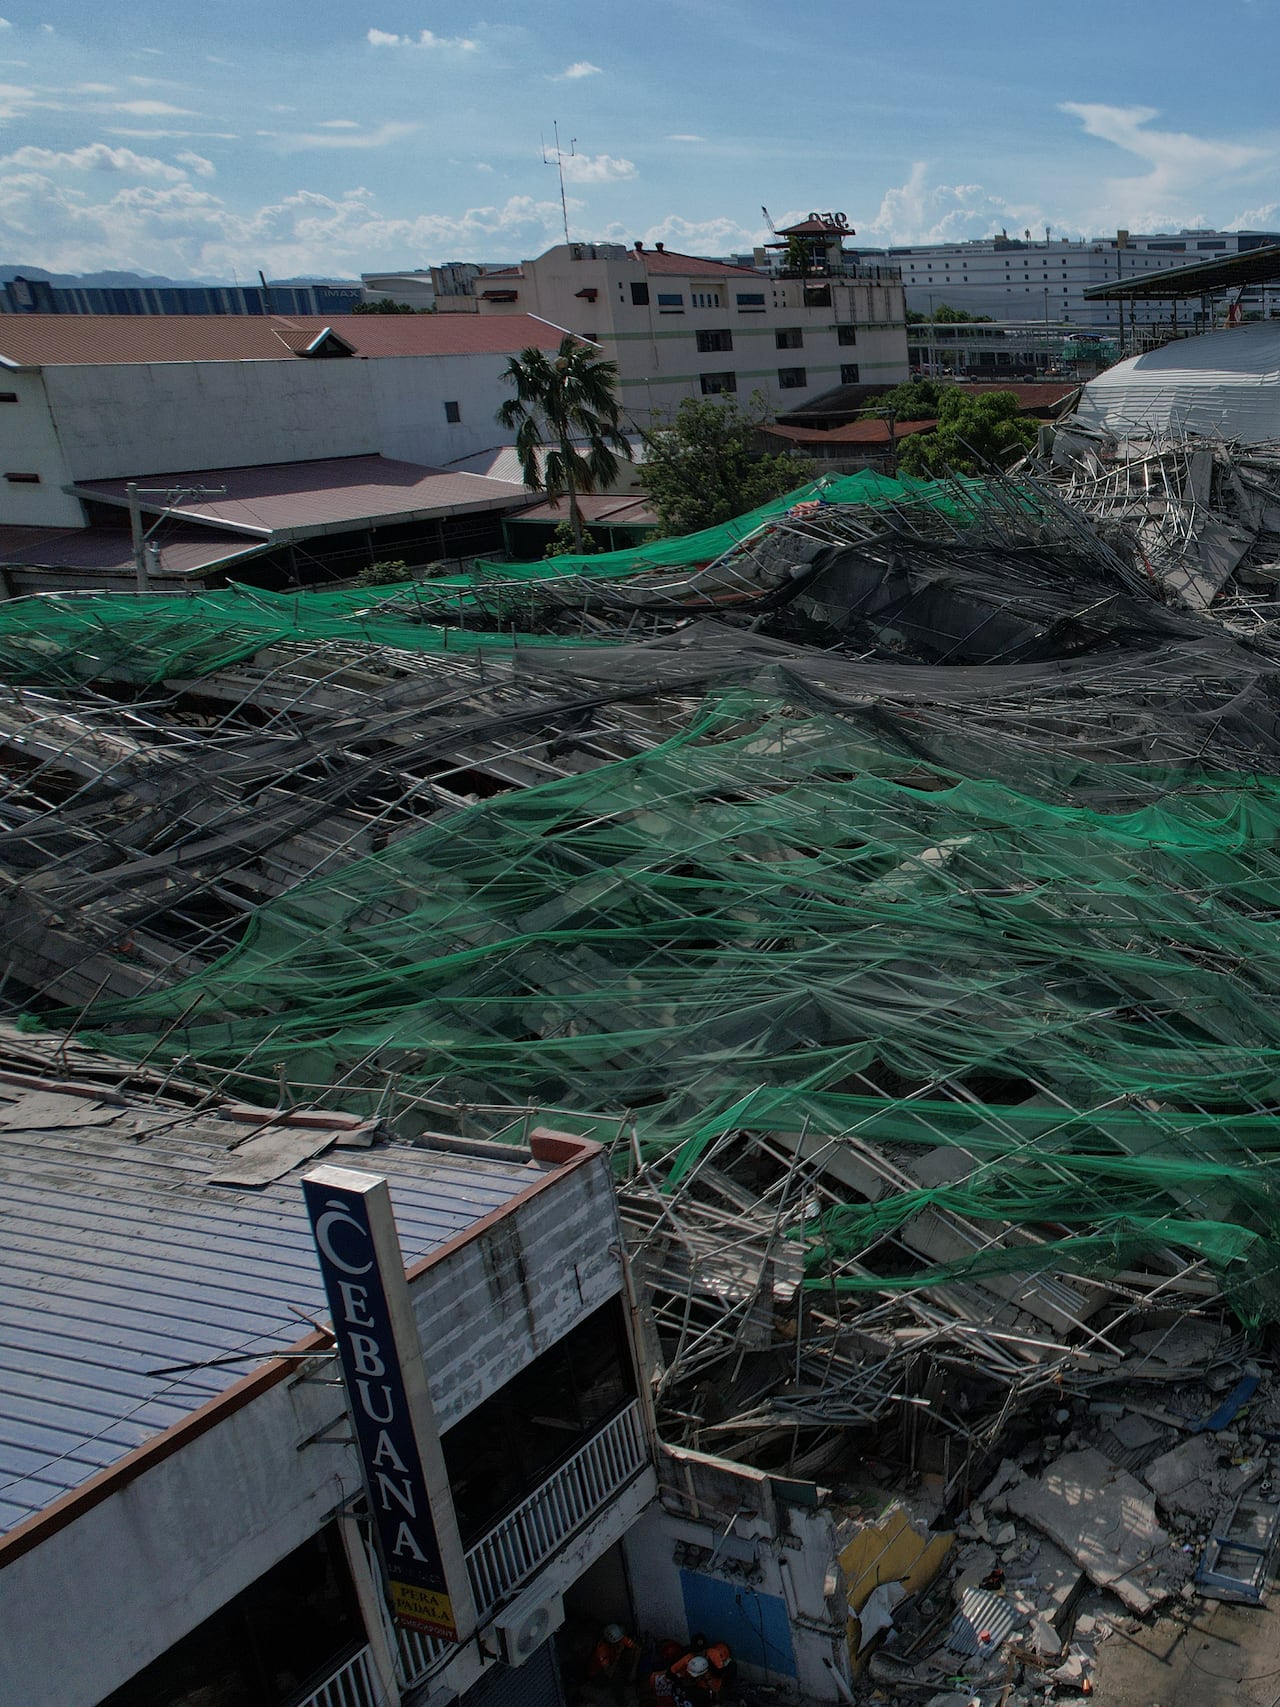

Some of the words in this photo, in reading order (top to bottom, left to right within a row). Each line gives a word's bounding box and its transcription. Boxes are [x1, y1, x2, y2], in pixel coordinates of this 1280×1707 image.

[315, 1209, 428, 1563] CEBUANA
[400, 1588, 439, 1606] PERA
[397, 1598, 450, 1621] PADALA
